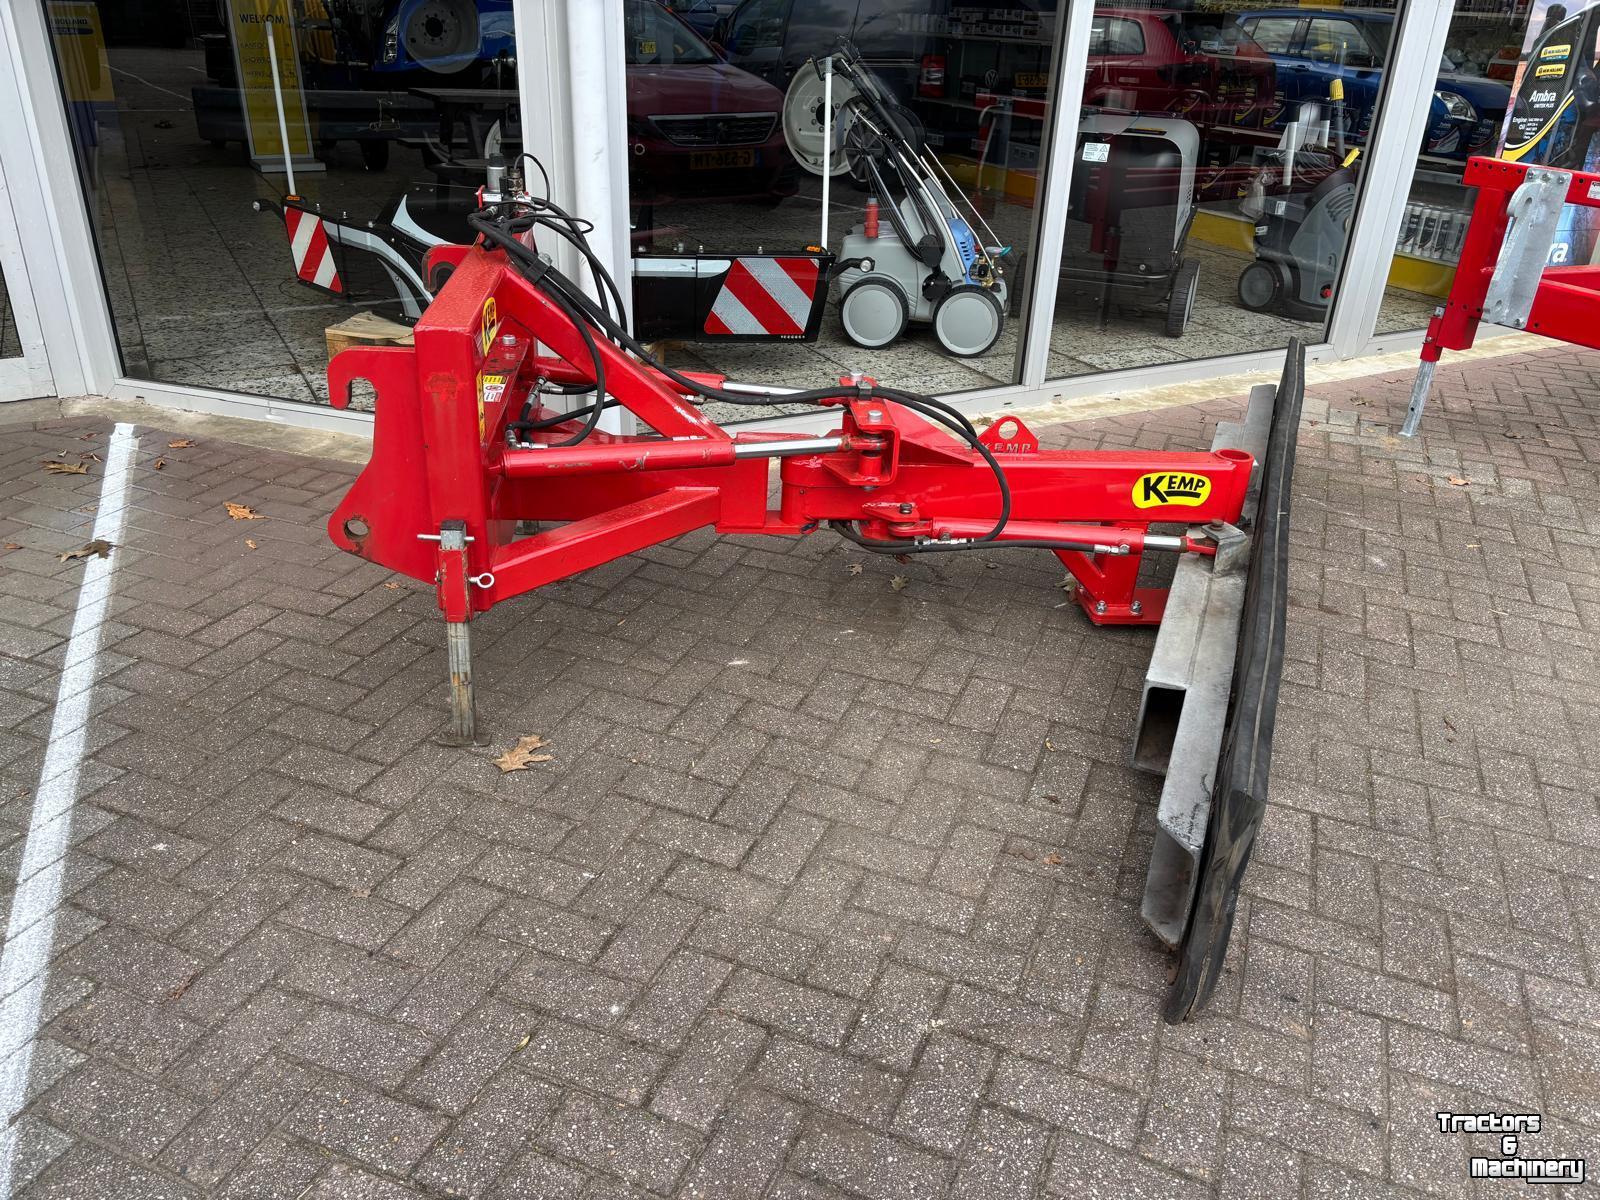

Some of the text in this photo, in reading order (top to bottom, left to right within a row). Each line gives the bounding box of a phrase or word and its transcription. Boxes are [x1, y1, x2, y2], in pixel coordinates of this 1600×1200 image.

[239, 13, 285, 24] WELKOM
[1529, 90, 1557, 102] Ambra
[1512, 116, 1528, 124] Engine
[1143, 475, 1206, 503] KEMP
